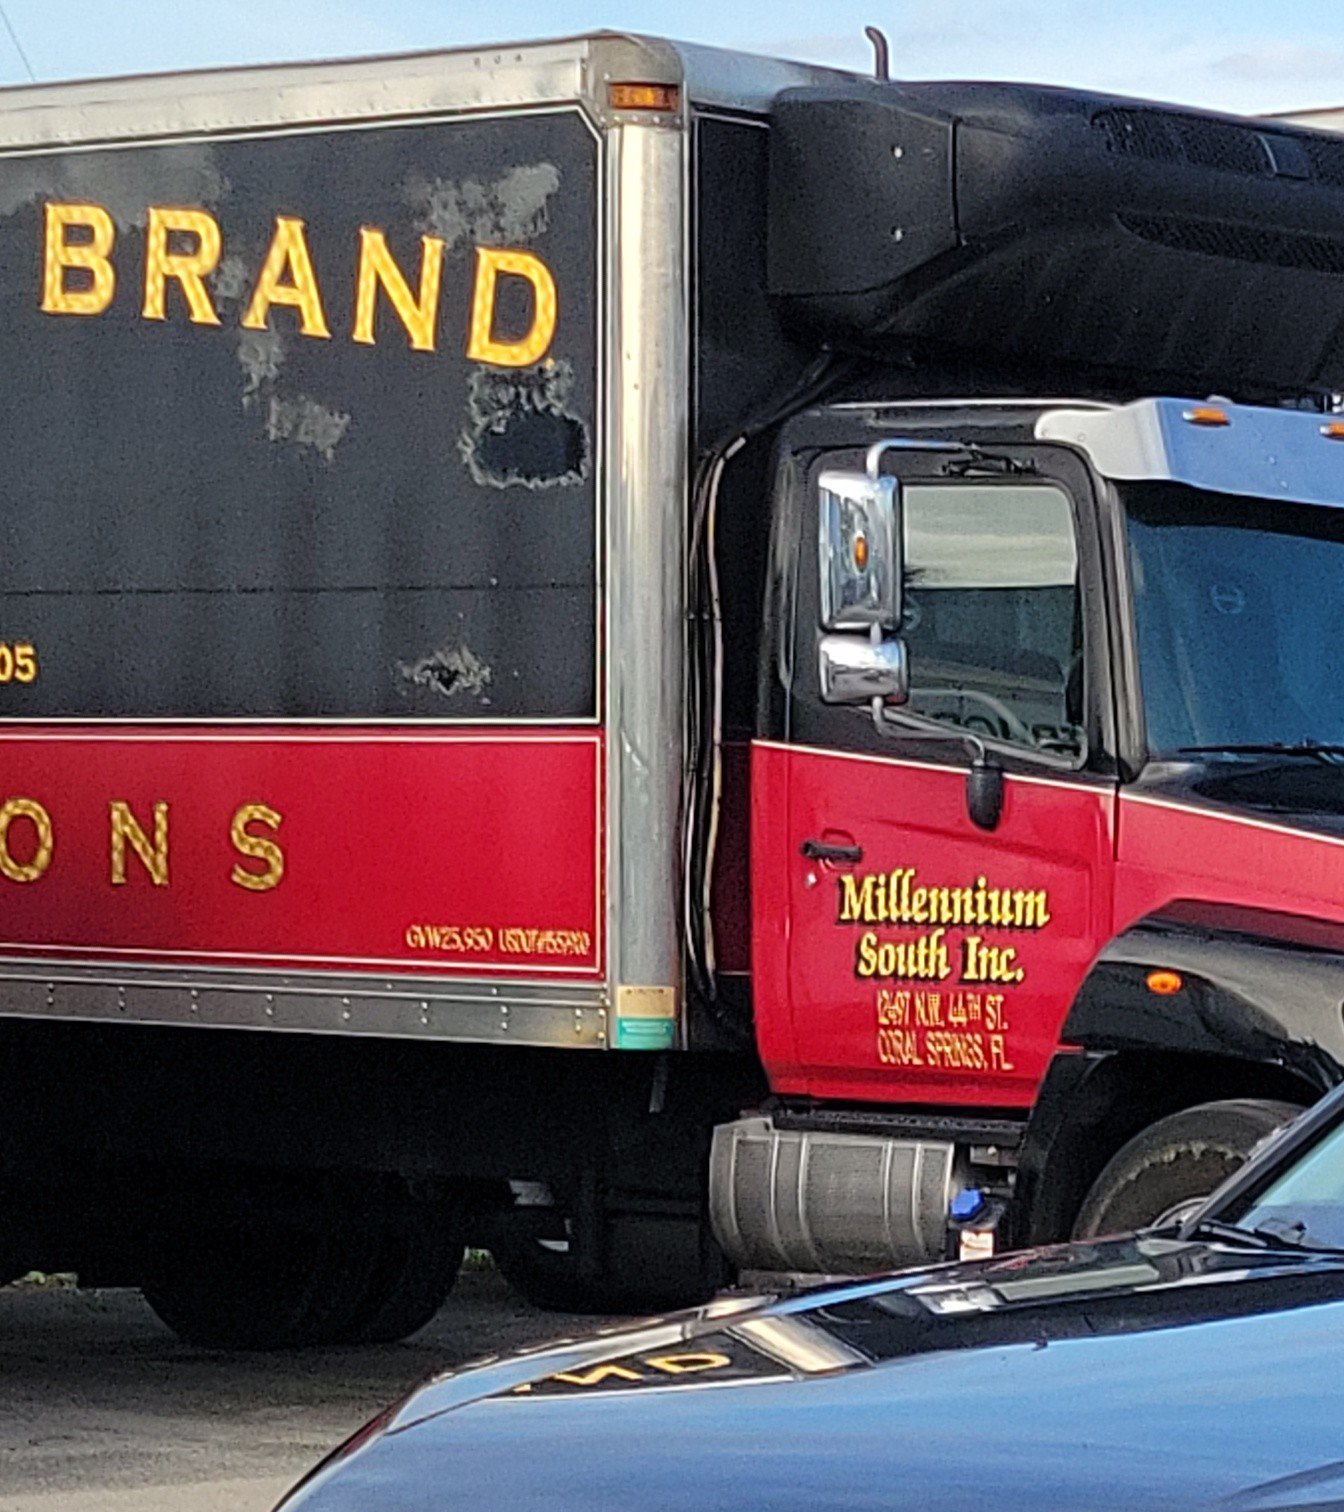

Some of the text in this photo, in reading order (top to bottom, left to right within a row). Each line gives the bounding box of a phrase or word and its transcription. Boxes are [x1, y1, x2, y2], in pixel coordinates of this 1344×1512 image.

[39, 201, 557, 368] BRAND
[838, 868, 1051, 928] Millennium
[857, 928, 1025, 983] South Inc.
[877, 1028, 924, 1066] CORAL
[990, 1034, 1014, 1071] FL
